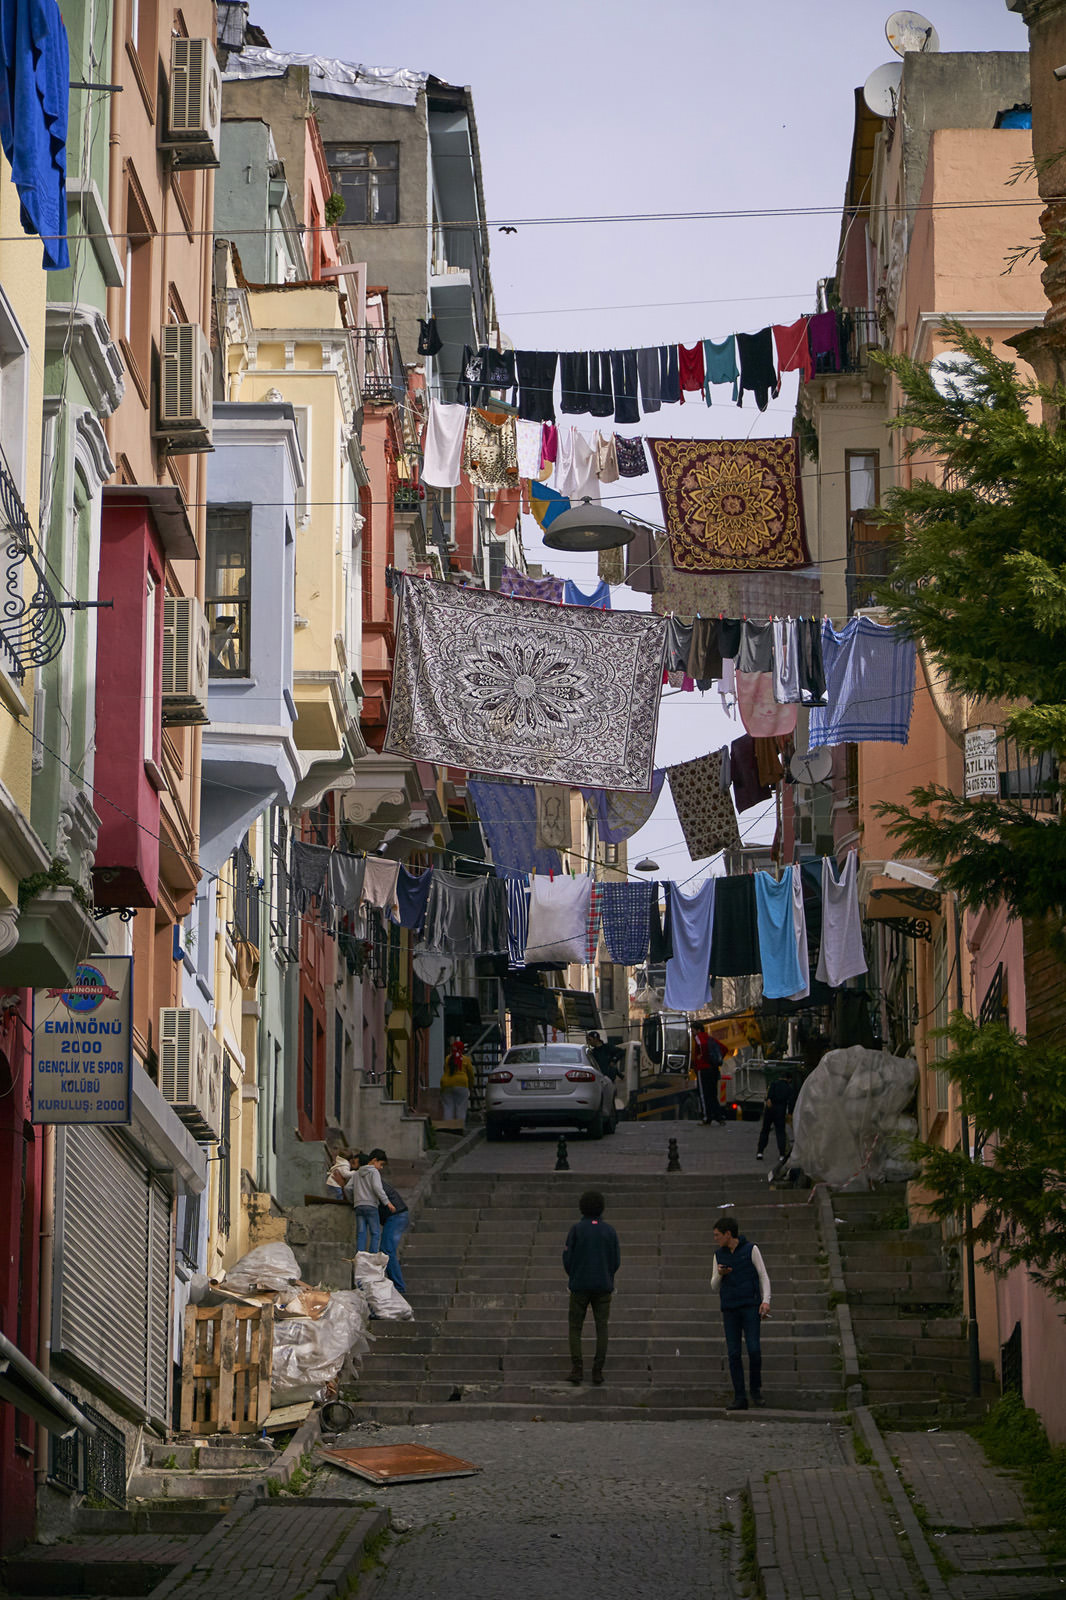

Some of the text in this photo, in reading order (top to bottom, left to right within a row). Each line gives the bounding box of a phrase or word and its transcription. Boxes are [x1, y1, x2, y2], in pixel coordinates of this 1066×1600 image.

[988, 777, 995, 788] 76
[44, 1018, 122, 1035] EMİNÖNÜ
[61, 1041, 102, 1054] 2000
[38, 1058, 123, 1076] GENÇLİK VE SPOR
[38, 1100, 125, 1113] KURULUŞ: 2000
